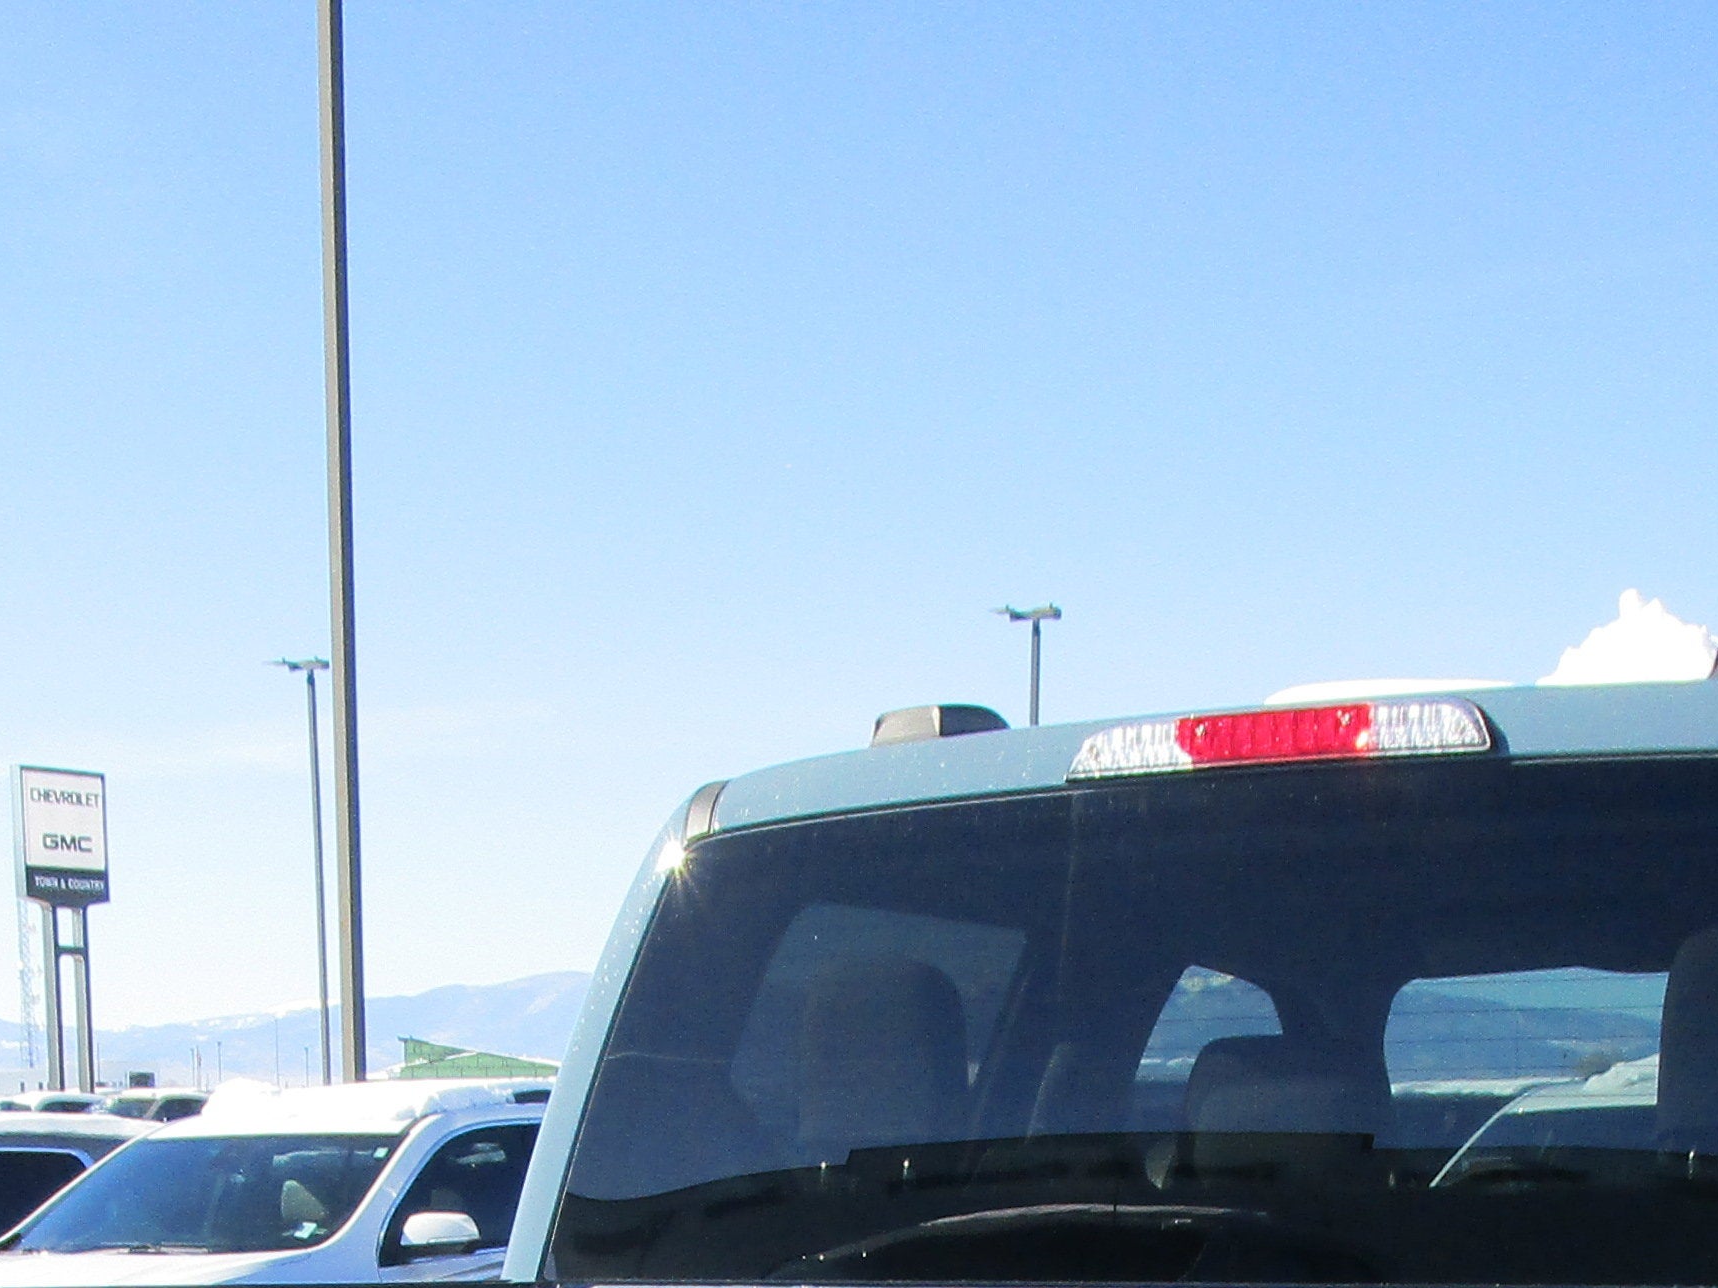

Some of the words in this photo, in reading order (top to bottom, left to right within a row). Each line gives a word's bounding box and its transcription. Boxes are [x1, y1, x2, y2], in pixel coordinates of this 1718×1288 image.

[29, 787, 100, 808] CHEVROLET
[42, 832, 93, 853] GMC
[34, 875, 58, 888] TOWN
